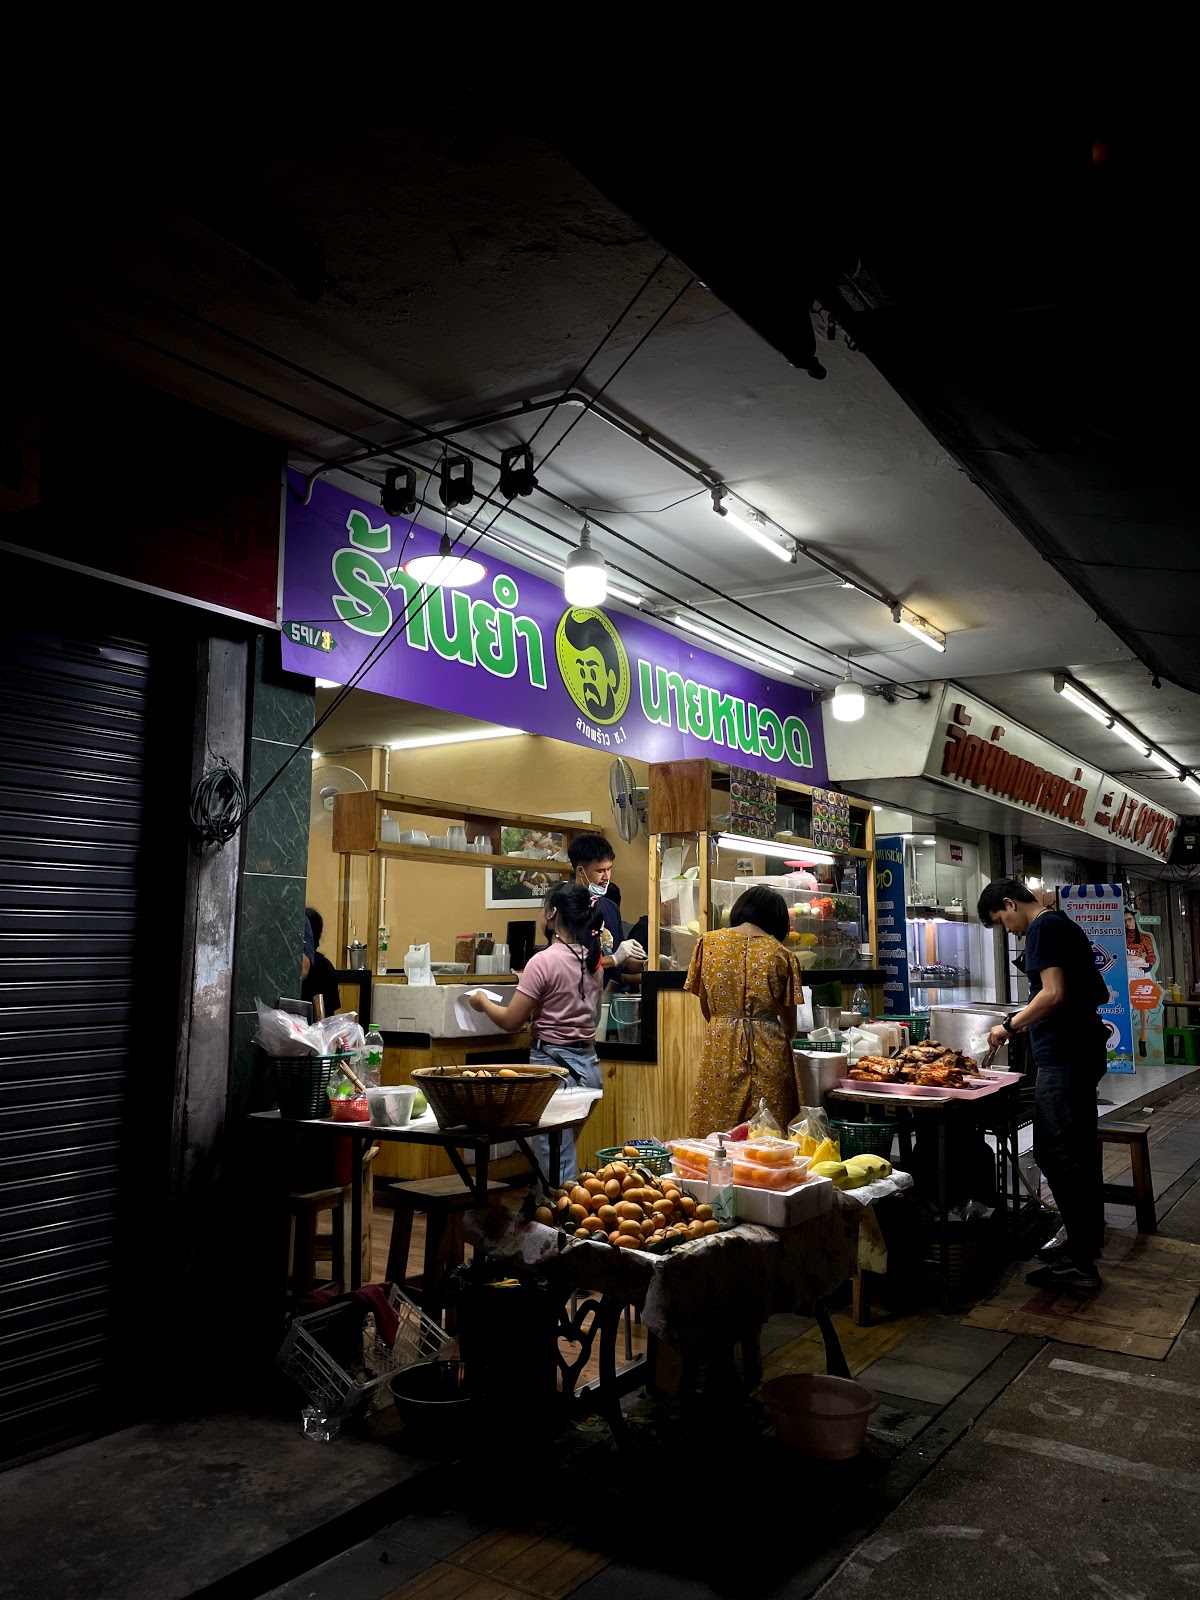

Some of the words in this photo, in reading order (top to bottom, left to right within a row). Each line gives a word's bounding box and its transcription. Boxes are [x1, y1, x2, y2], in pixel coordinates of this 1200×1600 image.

[332, 509, 548, 689] ร้านยำ
[576, 717, 611, 746] ลาดพร้าว
[638, 659, 813, 768] นายหนวด
